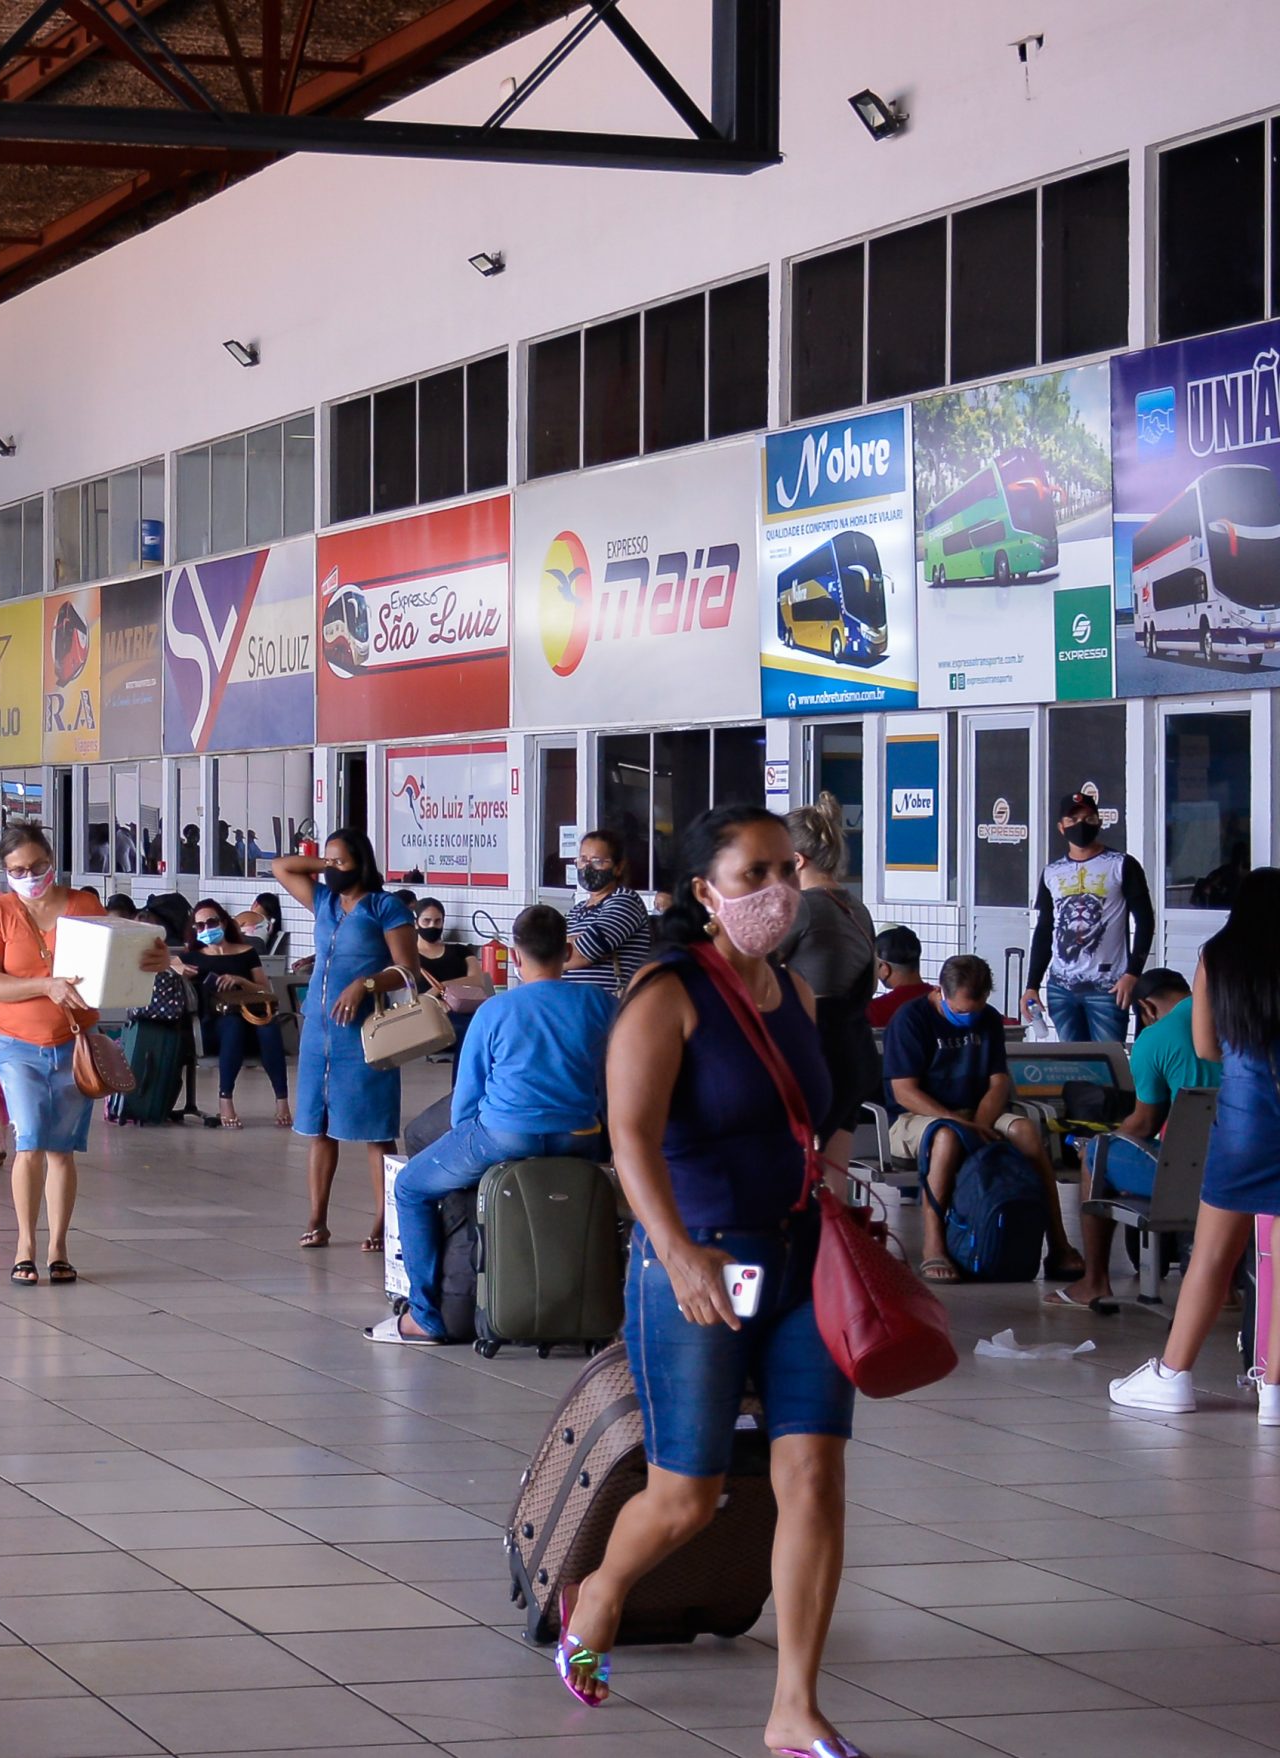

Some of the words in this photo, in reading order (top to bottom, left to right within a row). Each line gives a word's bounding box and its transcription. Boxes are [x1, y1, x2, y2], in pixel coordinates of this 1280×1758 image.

[776, 427, 890, 508] Nobre
[766, 525, 800, 541] QUALIDADE
[801, 524, 805, 535] E
[805, 519, 839, 535] CONFORTO
[840, 518, 849, 529] NA
[849, 514, 867, 527] HORA
[869, 513, 878, 524] DE
[879, 509, 904, 523] VIAJAR!
[607, 535, 649, 559] EXPRESSO
[391, 586, 448, 613] Expresso
[374, 603, 419, 653] São
[428, 592, 502, 645] Luiz
[104, 624, 158, 664] MATRIZ
[248, 635, 275, 678] SÃO
[279, 634, 309, 674] LUIZ
[1058, 648, 1108, 661] EXPRESSO
[420, 796, 439, 819] São
[442, 795, 463, 819] Luiz
[895, 793, 931, 813] Nobre
[402, 834, 432, 847] CARGAS
[434, 834, 438, 847] E
[440, 834, 497, 848] ENCOMENDAS
[979, 825, 1027, 838] EXPRESSO
